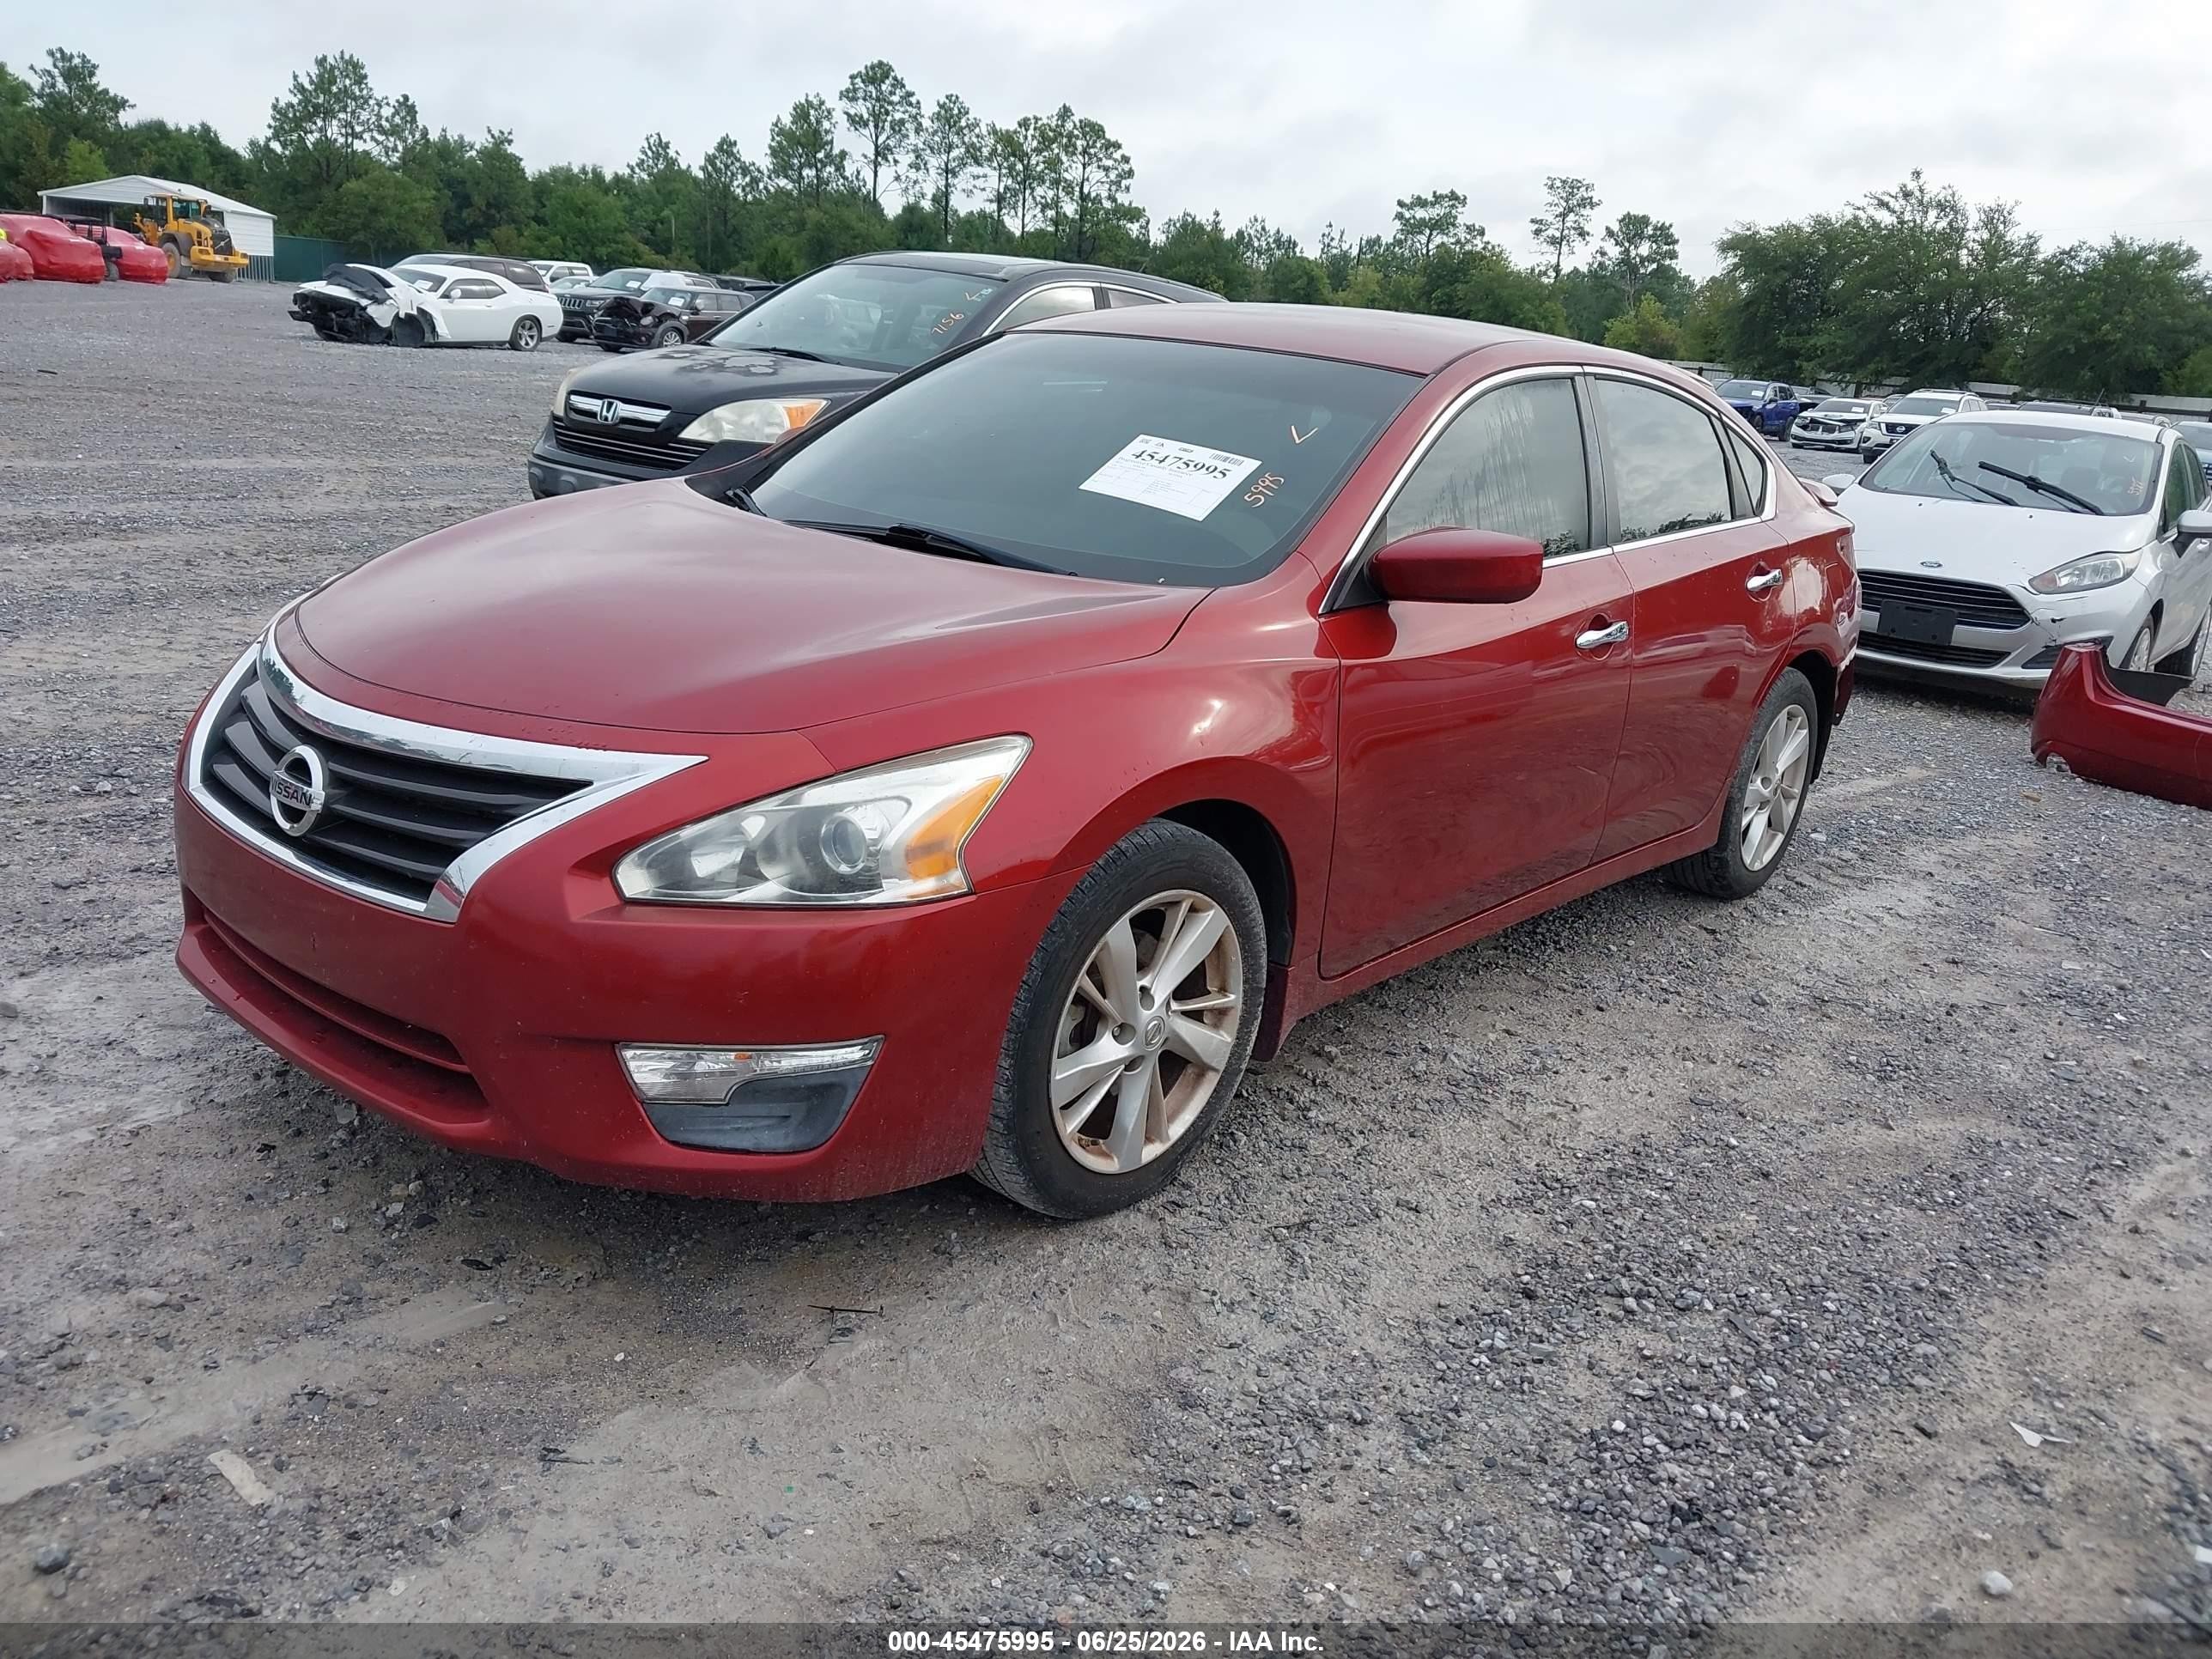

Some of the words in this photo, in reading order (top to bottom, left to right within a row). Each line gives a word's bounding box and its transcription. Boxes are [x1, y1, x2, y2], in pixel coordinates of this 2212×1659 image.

[1131, 450, 1231, 479] 45475995
[1244, 472, 1285, 507] 5995
[270, 775, 312, 806] NISSAN
